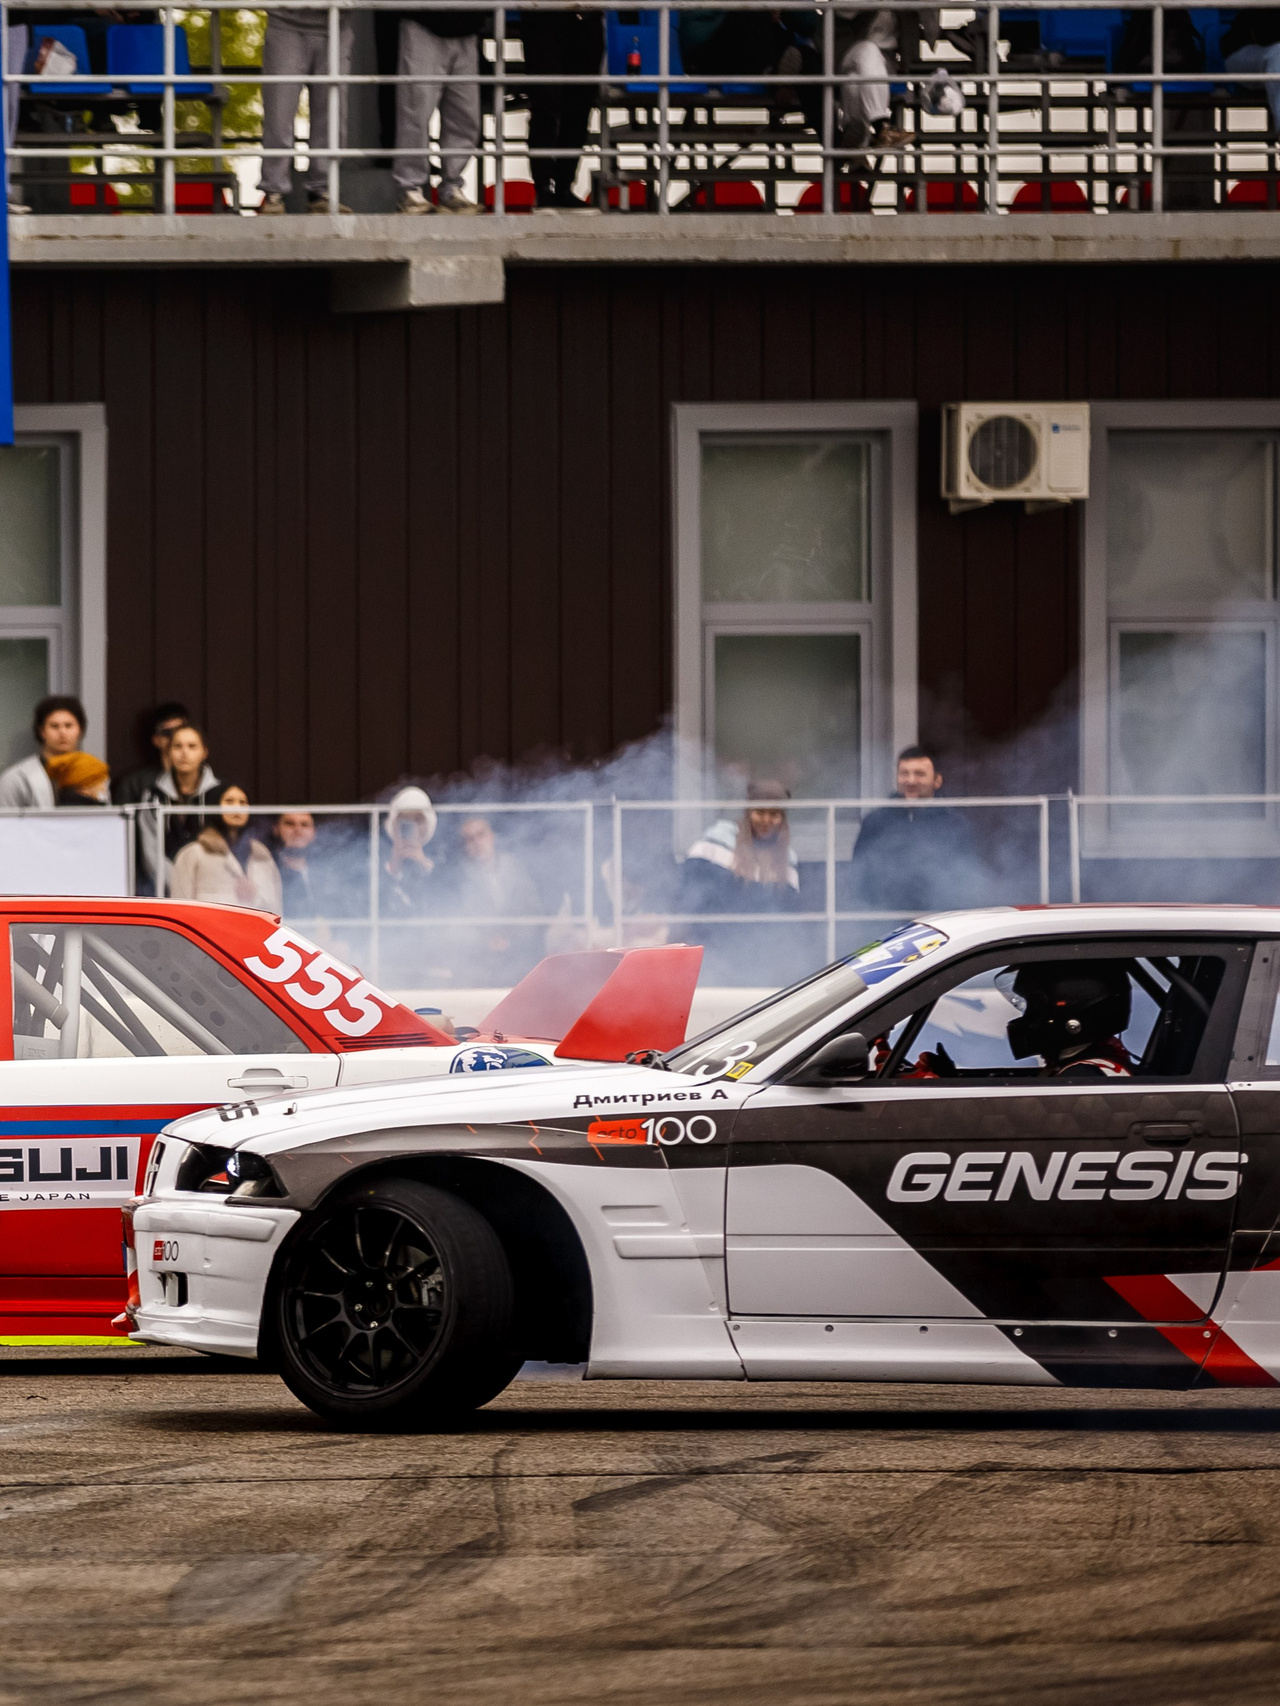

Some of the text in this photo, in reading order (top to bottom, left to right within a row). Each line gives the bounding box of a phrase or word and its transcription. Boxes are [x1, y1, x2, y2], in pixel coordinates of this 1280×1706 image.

[242, 927, 400, 1037] 555
[573, 1090, 702, 1108] Дмитриев
[885, 1150, 1250, 1203] GENESIS
[19, 1192, 91, 1202] JAPAN
